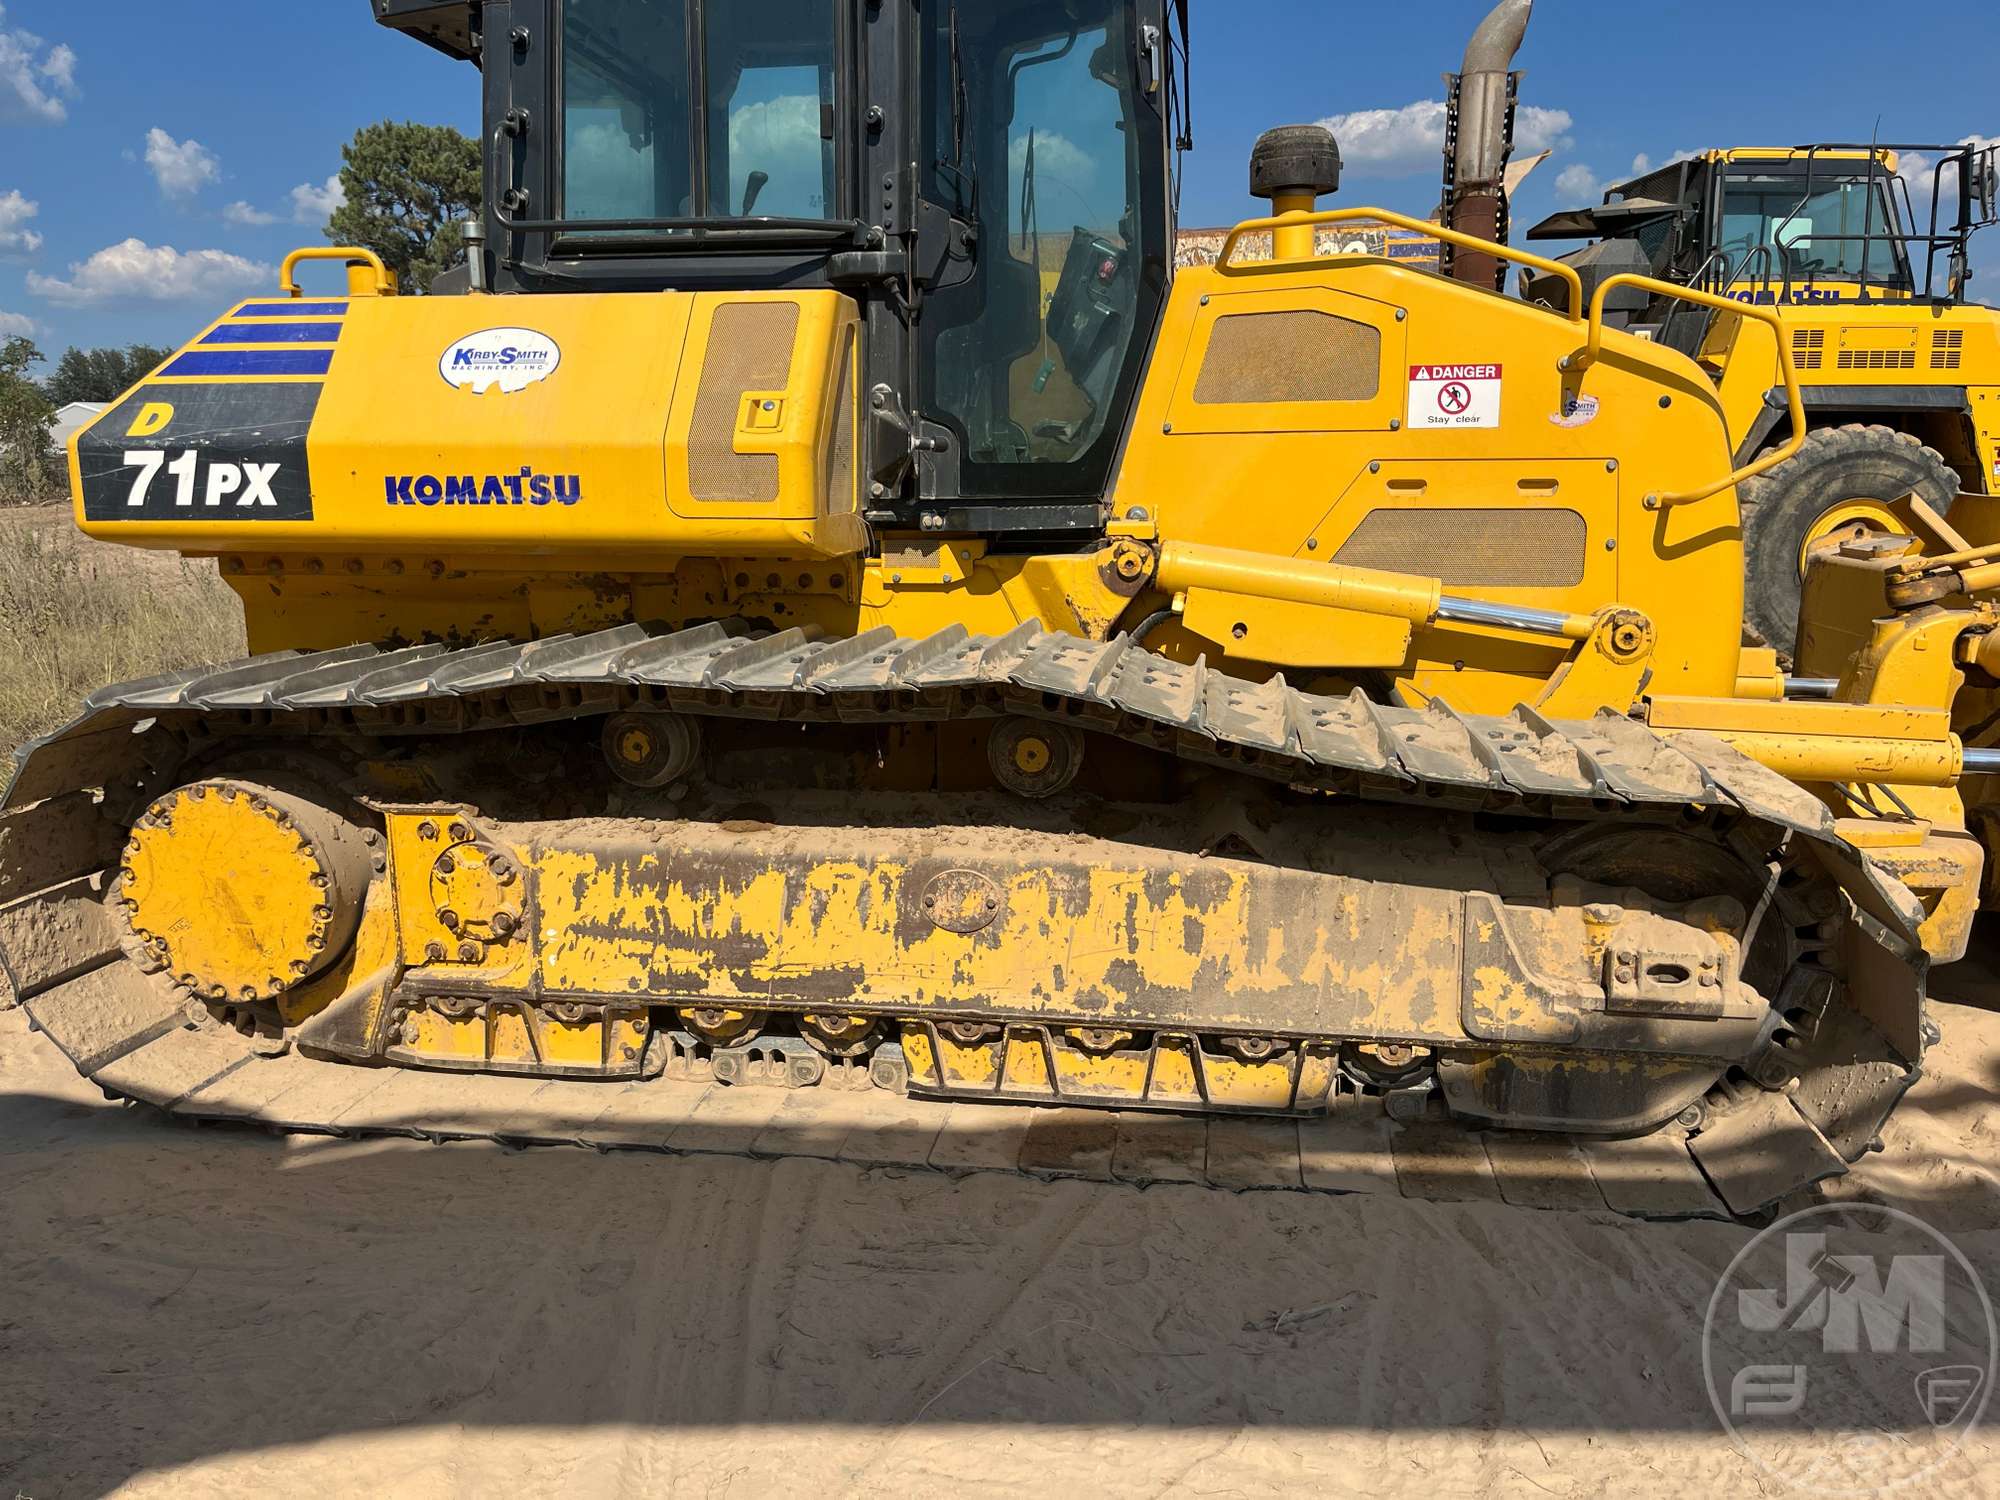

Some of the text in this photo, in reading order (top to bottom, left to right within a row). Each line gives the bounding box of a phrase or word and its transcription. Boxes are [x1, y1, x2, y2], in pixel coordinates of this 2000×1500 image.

[1432, 366, 1497, 380] DANGER
[126, 402, 174, 437] D
[1428, 415, 1480, 425] Stay clear
[385, 466, 580, 505] KOMATSU
